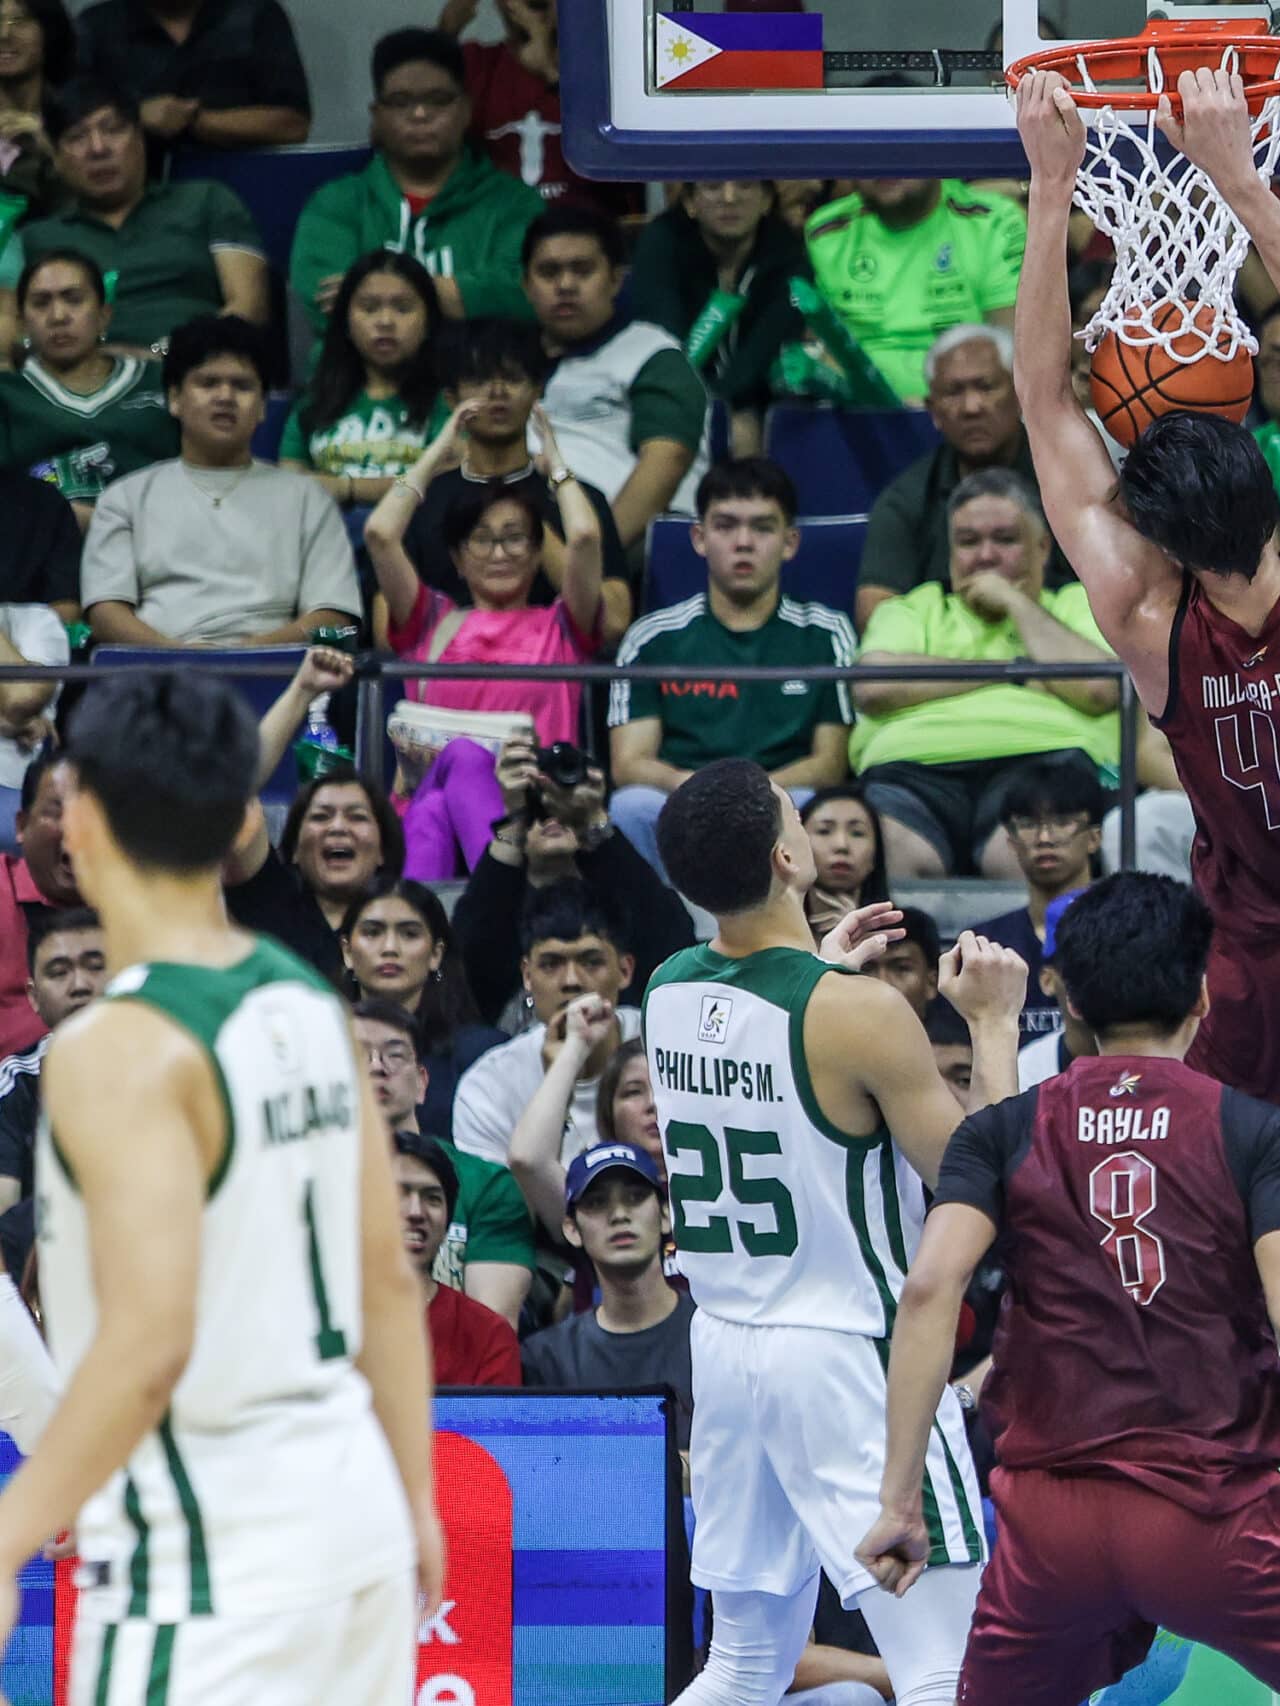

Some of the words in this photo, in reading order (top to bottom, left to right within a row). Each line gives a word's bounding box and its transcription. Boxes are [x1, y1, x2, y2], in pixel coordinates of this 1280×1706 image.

[655, 1047, 753, 1100] PHILLIPS
[756, 1062, 784, 1102] M.
[1077, 1106, 1171, 1145] BAYLA
[665, 1119, 799, 1258] 25
[1089, 1150, 1167, 1306] 8
